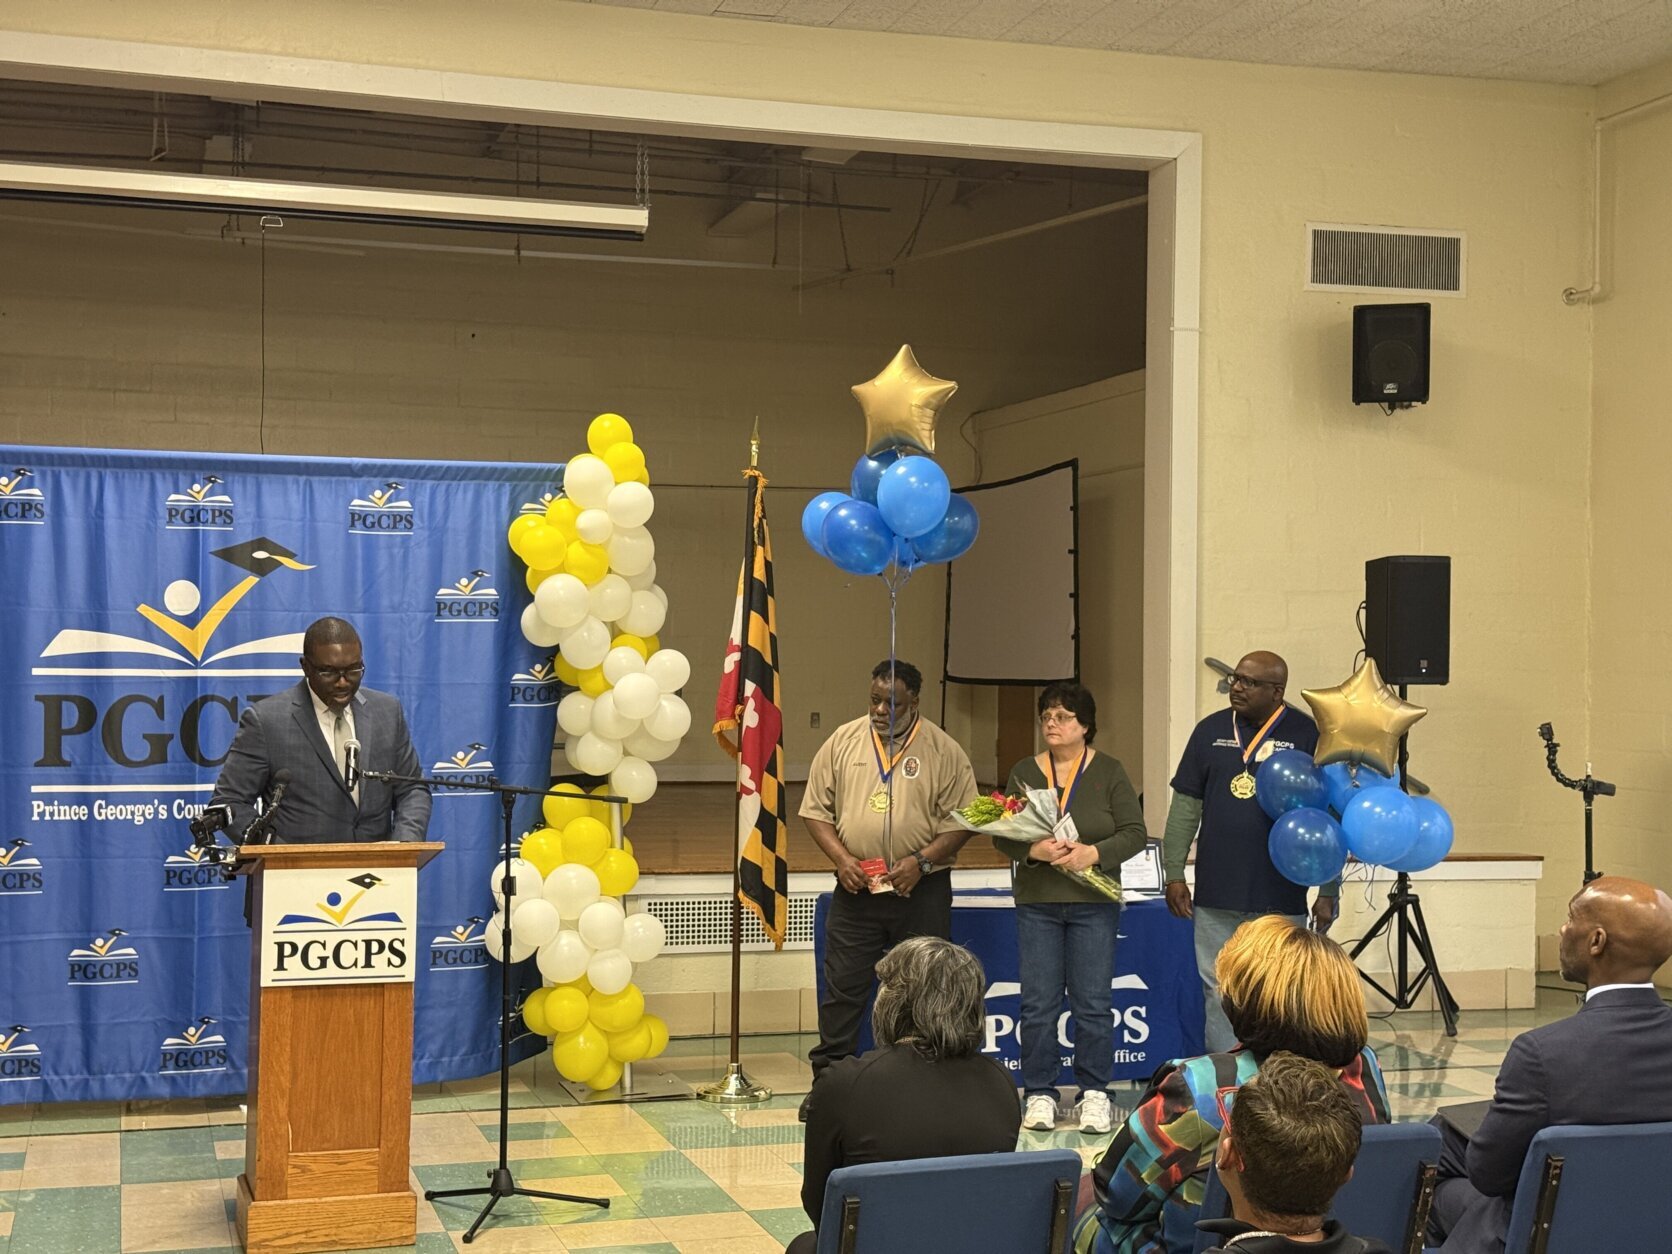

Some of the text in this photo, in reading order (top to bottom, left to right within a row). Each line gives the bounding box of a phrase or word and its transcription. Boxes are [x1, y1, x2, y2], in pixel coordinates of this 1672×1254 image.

[0, 501, 45, 519] CPS
[166, 507, 234, 525] PGCPS
[350, 511, 414, 530] PGCPS
[435, 601, 499, 617] PGCPS
[34, 694, 273, 769] PGC
[32, 800, 88, 821] Prince
[93, 799, 167, 824] George's
[0, 871, 43, 890] CPS
[273, 937, 407, 972] PGCPS
[68, 961, 139, 980] PGCPS
[160, 1049, 227, 1069] PGCPS
[1113, 1050, 1146, 1063] ffice
[0, 1058, 42, 1076] CPS
